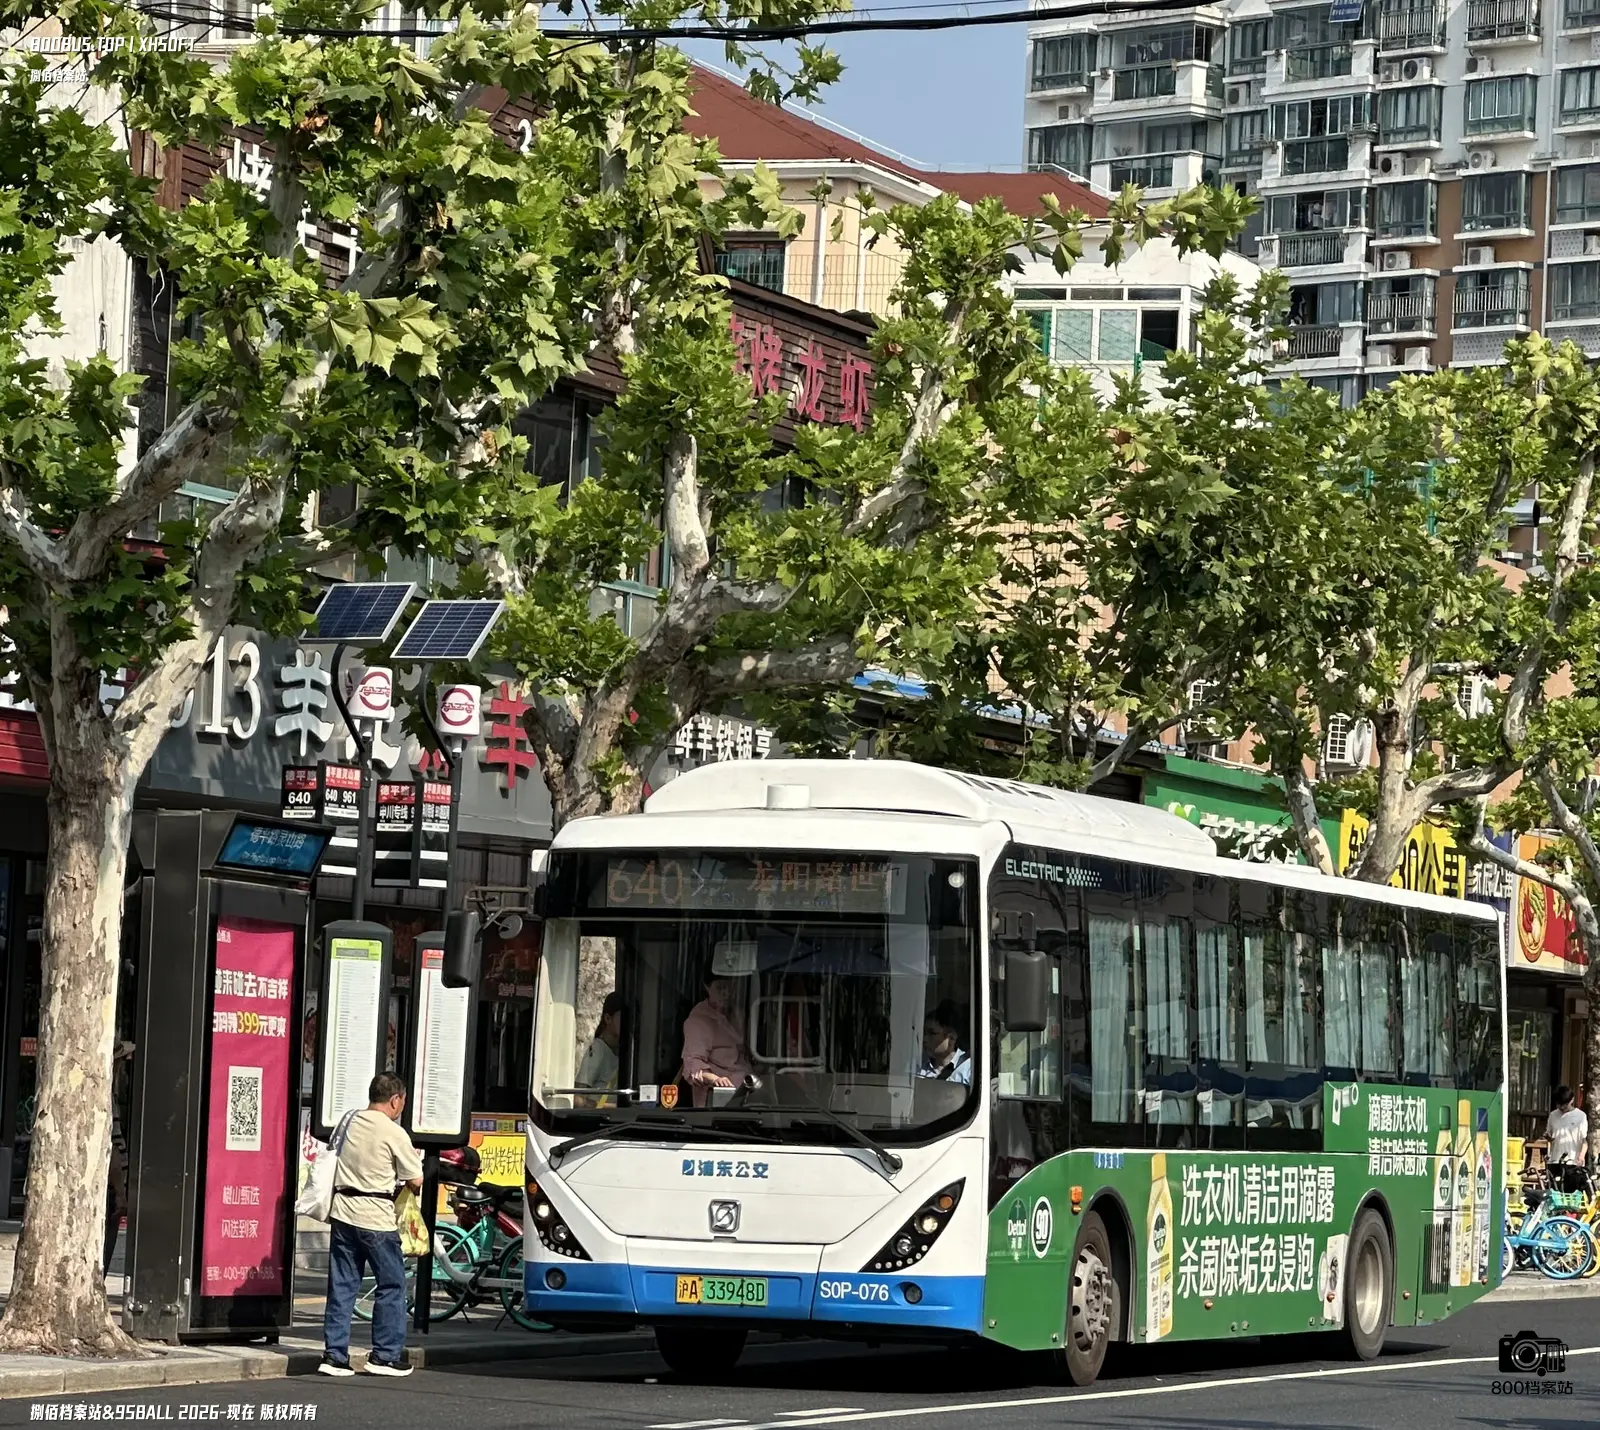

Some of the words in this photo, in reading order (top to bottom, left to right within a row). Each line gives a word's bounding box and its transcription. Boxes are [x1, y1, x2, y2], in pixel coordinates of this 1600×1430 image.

[288, 791, 311, 804] 640
[325, 788, 338, 802] 640
[342, 790, 357, 804] 961
[608, 858, 684, 906] 640
[1005, 858, 1064, 883] ELECTRIC
[1367, 1093, 1429, 1134] 滴露洗衣机
[698, 1159, 769, 1179] 浦东公交
[1367, 1137, 1429, 1177] 清洁除菌液
[1180, 1163, 1335, 1227] 洗衣机清洁用滴露
[221, 1219, 259, 1239] 闪送到家
[1007, 1218, 1027, 1237] Dettol
[1035, 1208, 1049, 1240] 90
[1177, 1232, 1315, 1299] 杀菌除垢免浸泡
